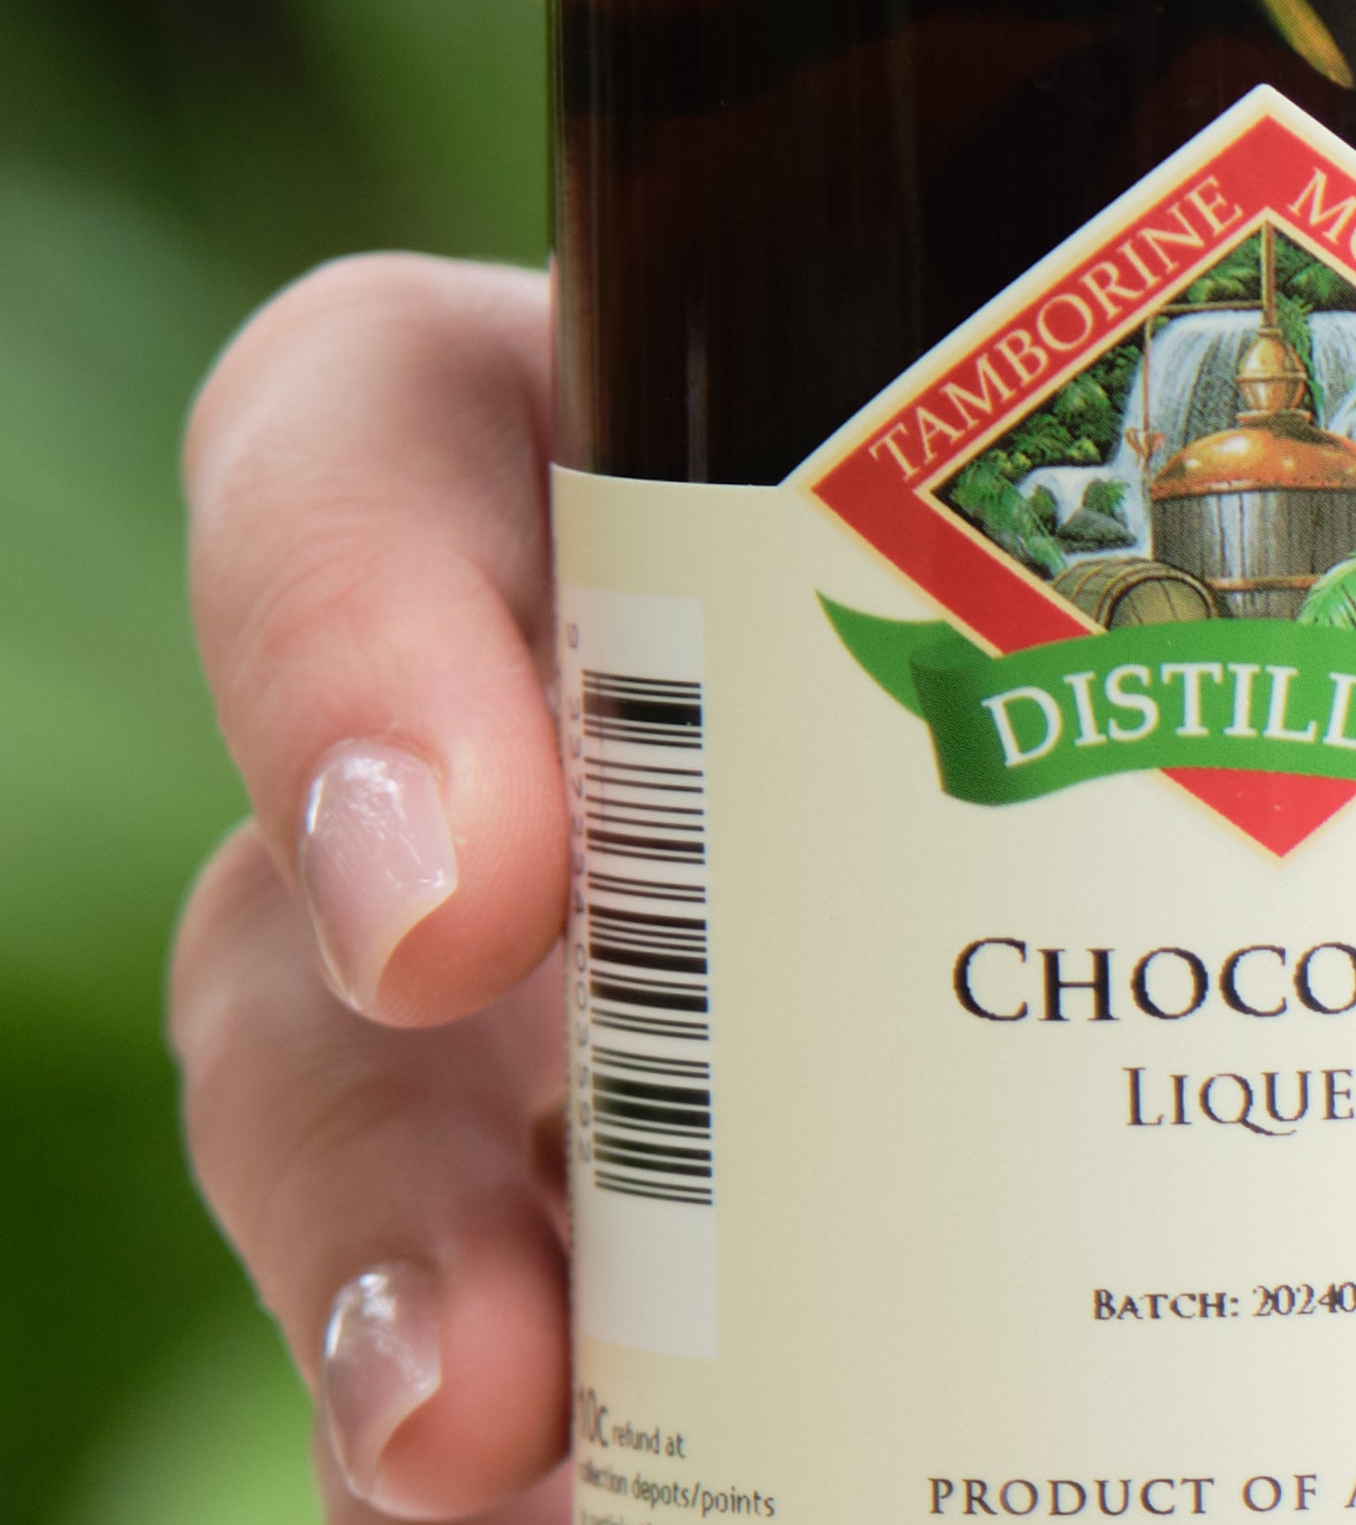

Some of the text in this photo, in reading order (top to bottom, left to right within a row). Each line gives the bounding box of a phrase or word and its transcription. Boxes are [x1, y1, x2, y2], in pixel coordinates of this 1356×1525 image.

[866, 173, 1246, 481] TAMBORINE
[664, 1433, 686, 1459] at
[631, 1471, 776, 1519] depots/points
[928, 1477, 1215, 1517] PRODUCT
[1242, 1474, 1317, 1513] OF
